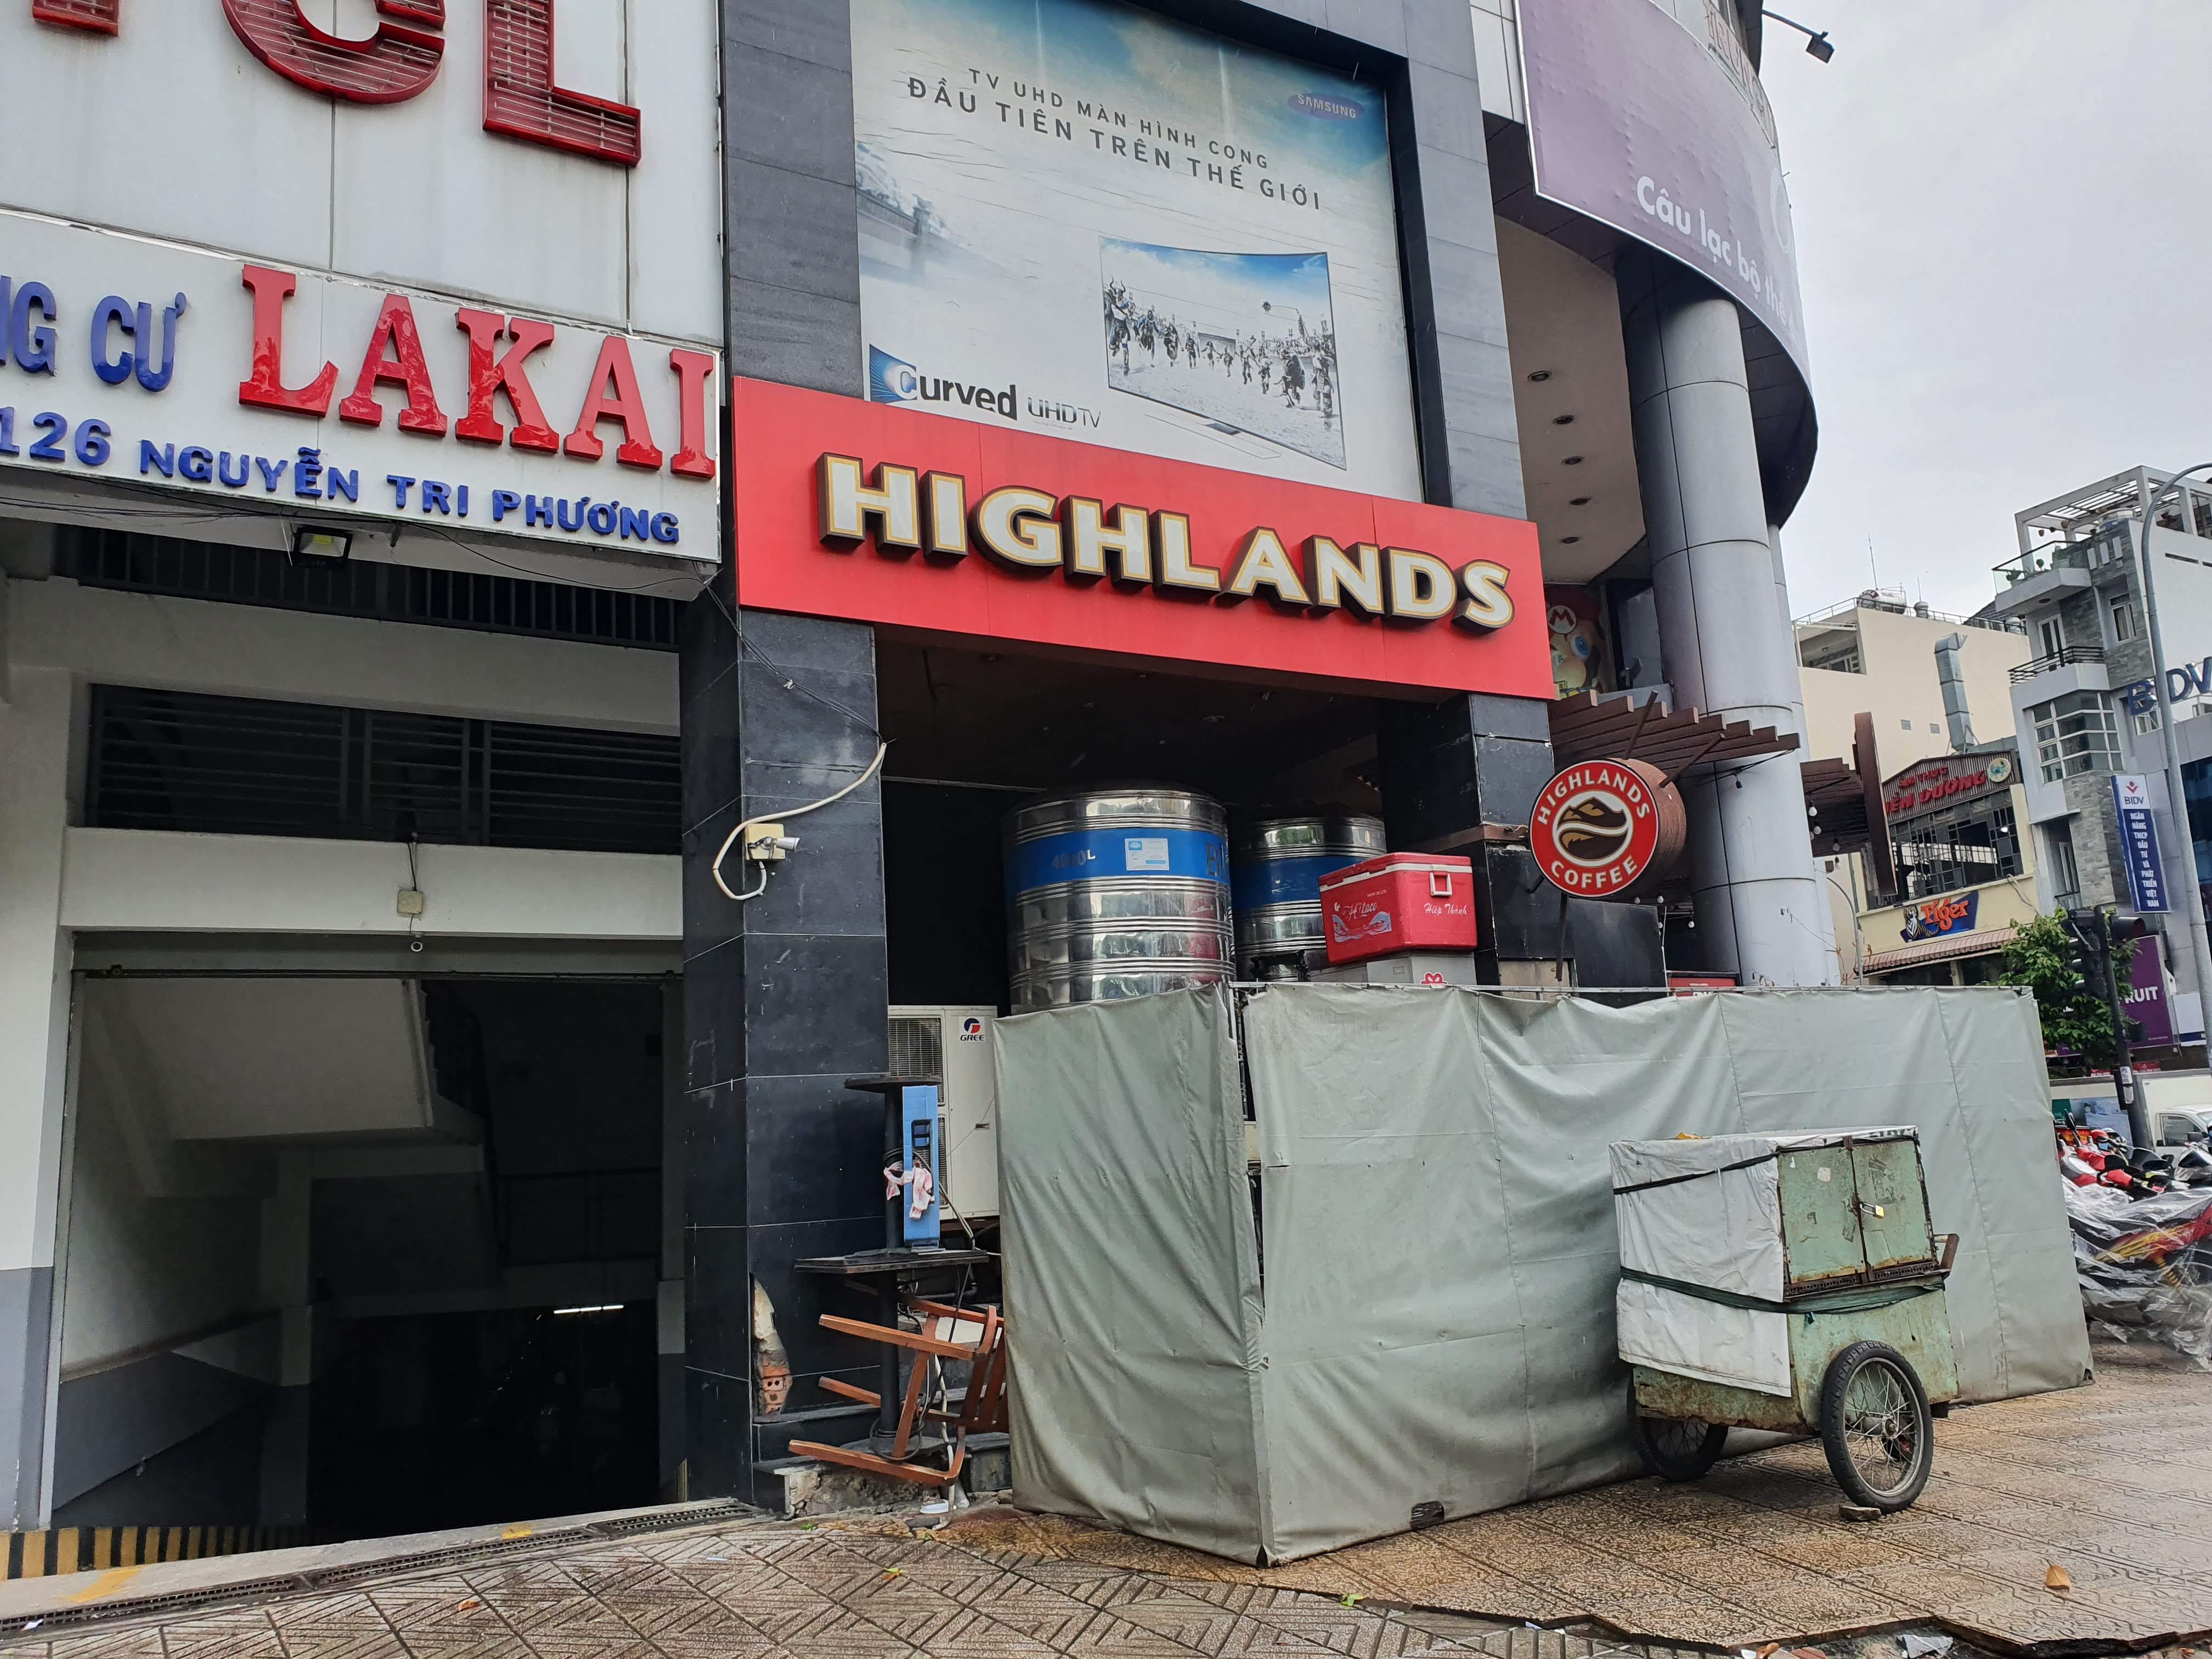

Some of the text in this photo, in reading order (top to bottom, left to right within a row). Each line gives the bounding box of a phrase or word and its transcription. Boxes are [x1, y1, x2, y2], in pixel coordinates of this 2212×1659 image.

[969, 68, 1268, 169] TV UHD MÀN HÌNH CONG
[1297, 94, 1356, 119] SAMSUNG
[907, 77, 1320, 210] ĐẦU TIÊN TRÊN THẾ GIỚI
[1637, 176, 1691, 235] Câu
[1700, 207, 1732, 267] lạc
[1737, 239, 1761, 300] bộ
[91, 291, 187, 392] CƯ
[239, 264, 716, 479] LAKAI
[891, 364, 1102, 428] Curved UHDTV
[0, 407, 679, 545] 126 NGUYỄN TRI PHƯƠNG
[816, 452, 1516, 634] HIGHLANDS
[2127, 656, 2212, 716] BDV
[1537, 769, 1651, 825] HIGHLANDS
[2124, 796, 2144, 805] BIDV
[1551, 855, 1638, 889] COFFEE
[1444, 903, 1468, 916] Thành
[1920, 897, 1969, 930] Tiger
[2121, 986, 2158, 1005] RUIT
